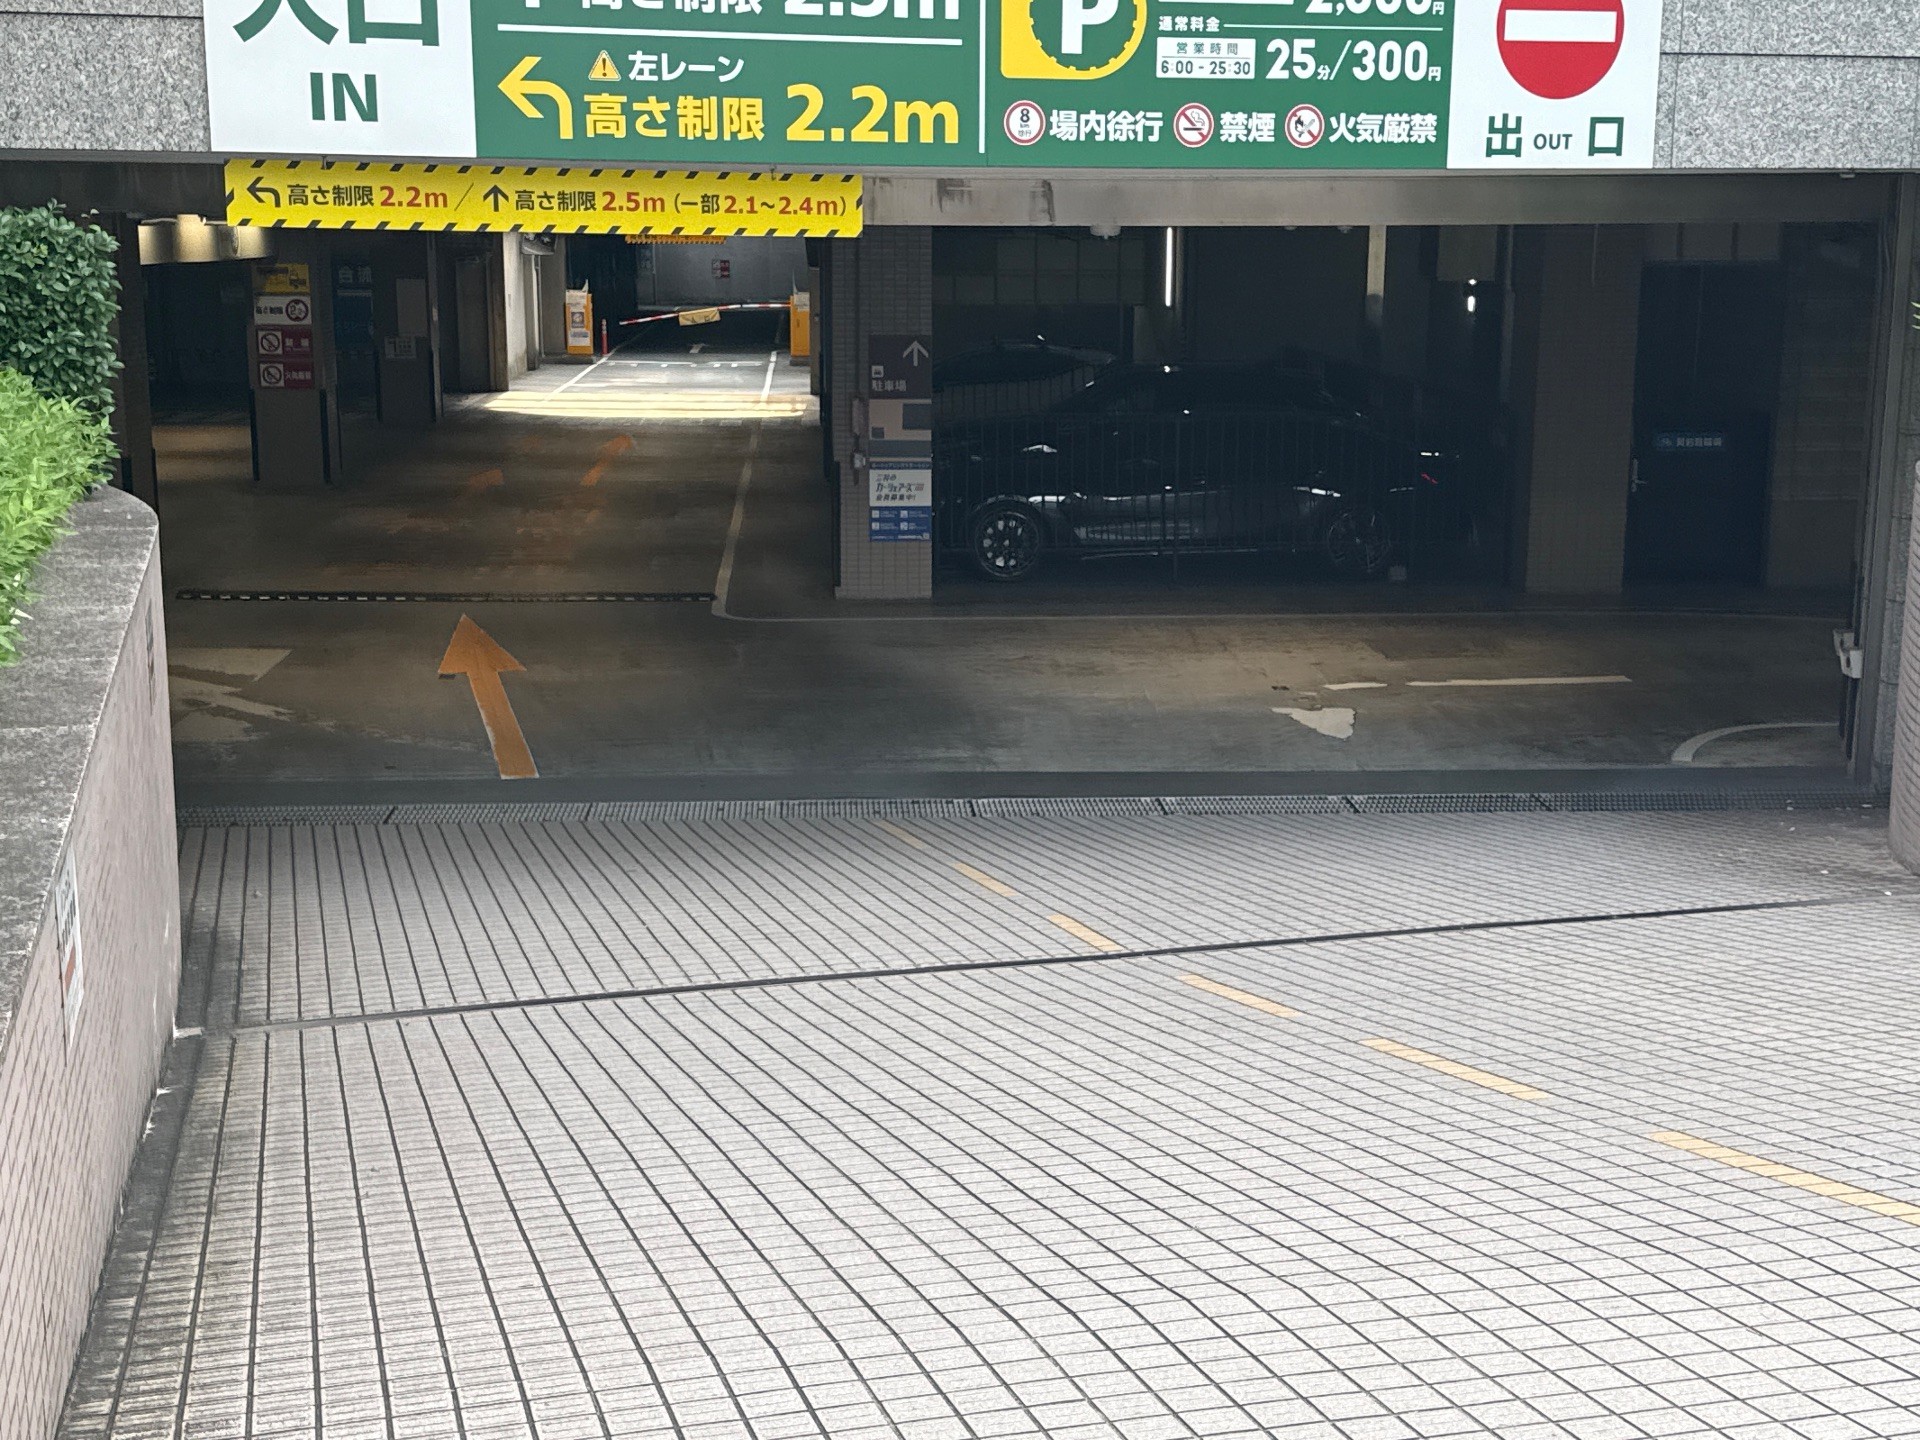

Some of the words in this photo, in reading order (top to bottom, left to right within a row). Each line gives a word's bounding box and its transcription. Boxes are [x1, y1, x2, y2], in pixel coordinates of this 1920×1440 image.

[1159, 16, 1221, 32] 通常料金
[1176, 42, 1239, 56] 営業時間
[628, 51, 745, 83] 左レーン
[1160, 60, 1194, 75] 6:00
[1208, 61, 1251, 76] 25:30
[310, 72, 378, 122] IN
[584, 94, 764, 142] 高さ制限
[785, 83, 959, 144] 2.2m
[1020, 108, 1031, 123] 8
[1049, 109, 1164, 142] 場内徐行
[1219, 112, 1276, 143] 禁煙
[1328, 113, 1438, 145] 火気厳禁
[1485, 113, 1523, 158] 出
[1533, 133, 1573, 151] OUT
[286, 184, 375, 208] 高さ制限
[379, 186, 449, 209] 2.2m
[514, 190, 598, 213] 高さ制限
[601, 191, 666, 214] 2.5m
[871, 379, 907, 392] 駐車場
